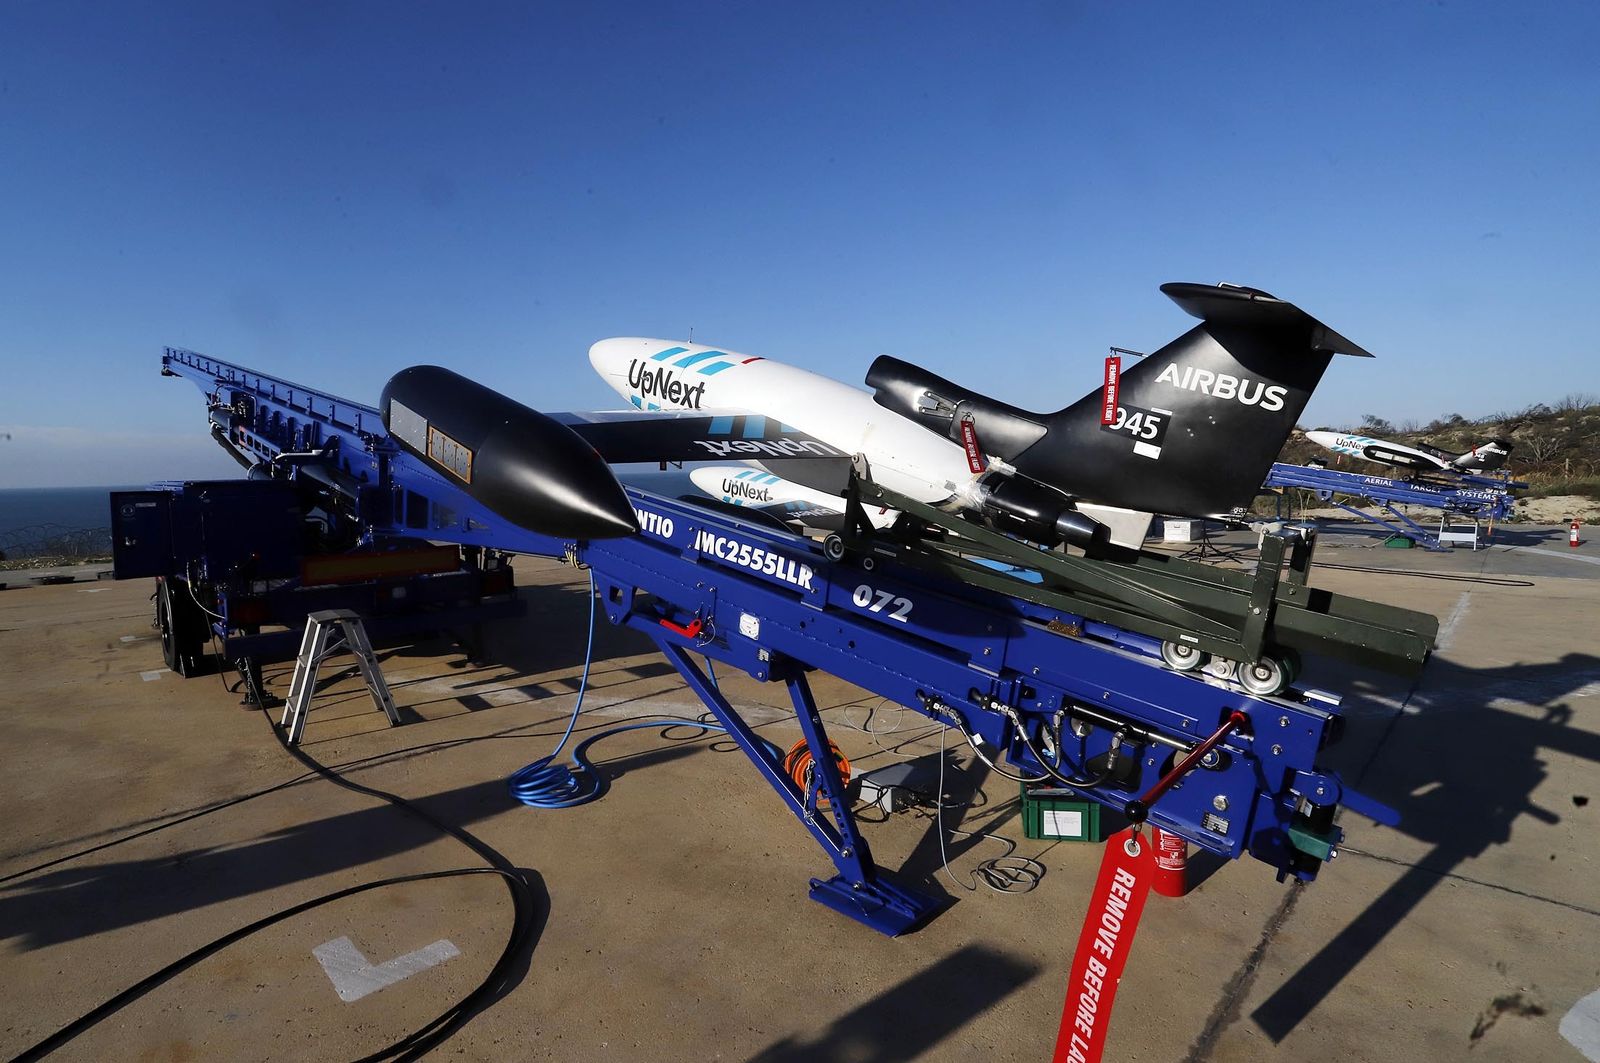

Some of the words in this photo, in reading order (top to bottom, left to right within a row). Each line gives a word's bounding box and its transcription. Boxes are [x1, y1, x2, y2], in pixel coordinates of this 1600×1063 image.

[628, 358, 706, 409] UpNext
[1108, 364, 1117, 385] REMOVE
[1106, 385, 1115, 404] BEFORE
[1155, 363, 1289, 412] AIRBUS
[1104, 404, 1114, 421] FLIGHT
[1109, 407, 1161, 440] 945
[693, 438, 839, 456] UpNext
[1335, 437, 1366, 450] UpNex
[722, 478, 768, 502] UpNext
[1364, 477, 1394, 487] AERIAL
[1409, 484, 1442, 493] TARGET
[1456, 489, 1497, 501] SYSTEMS
[694, 530, 814, 590] MC2555LLR
[852, 584, 914, 623] 072
[1093, 866, 1136, 960] REMOVE
[1074, 956, 1108, 1038] BEFORE
